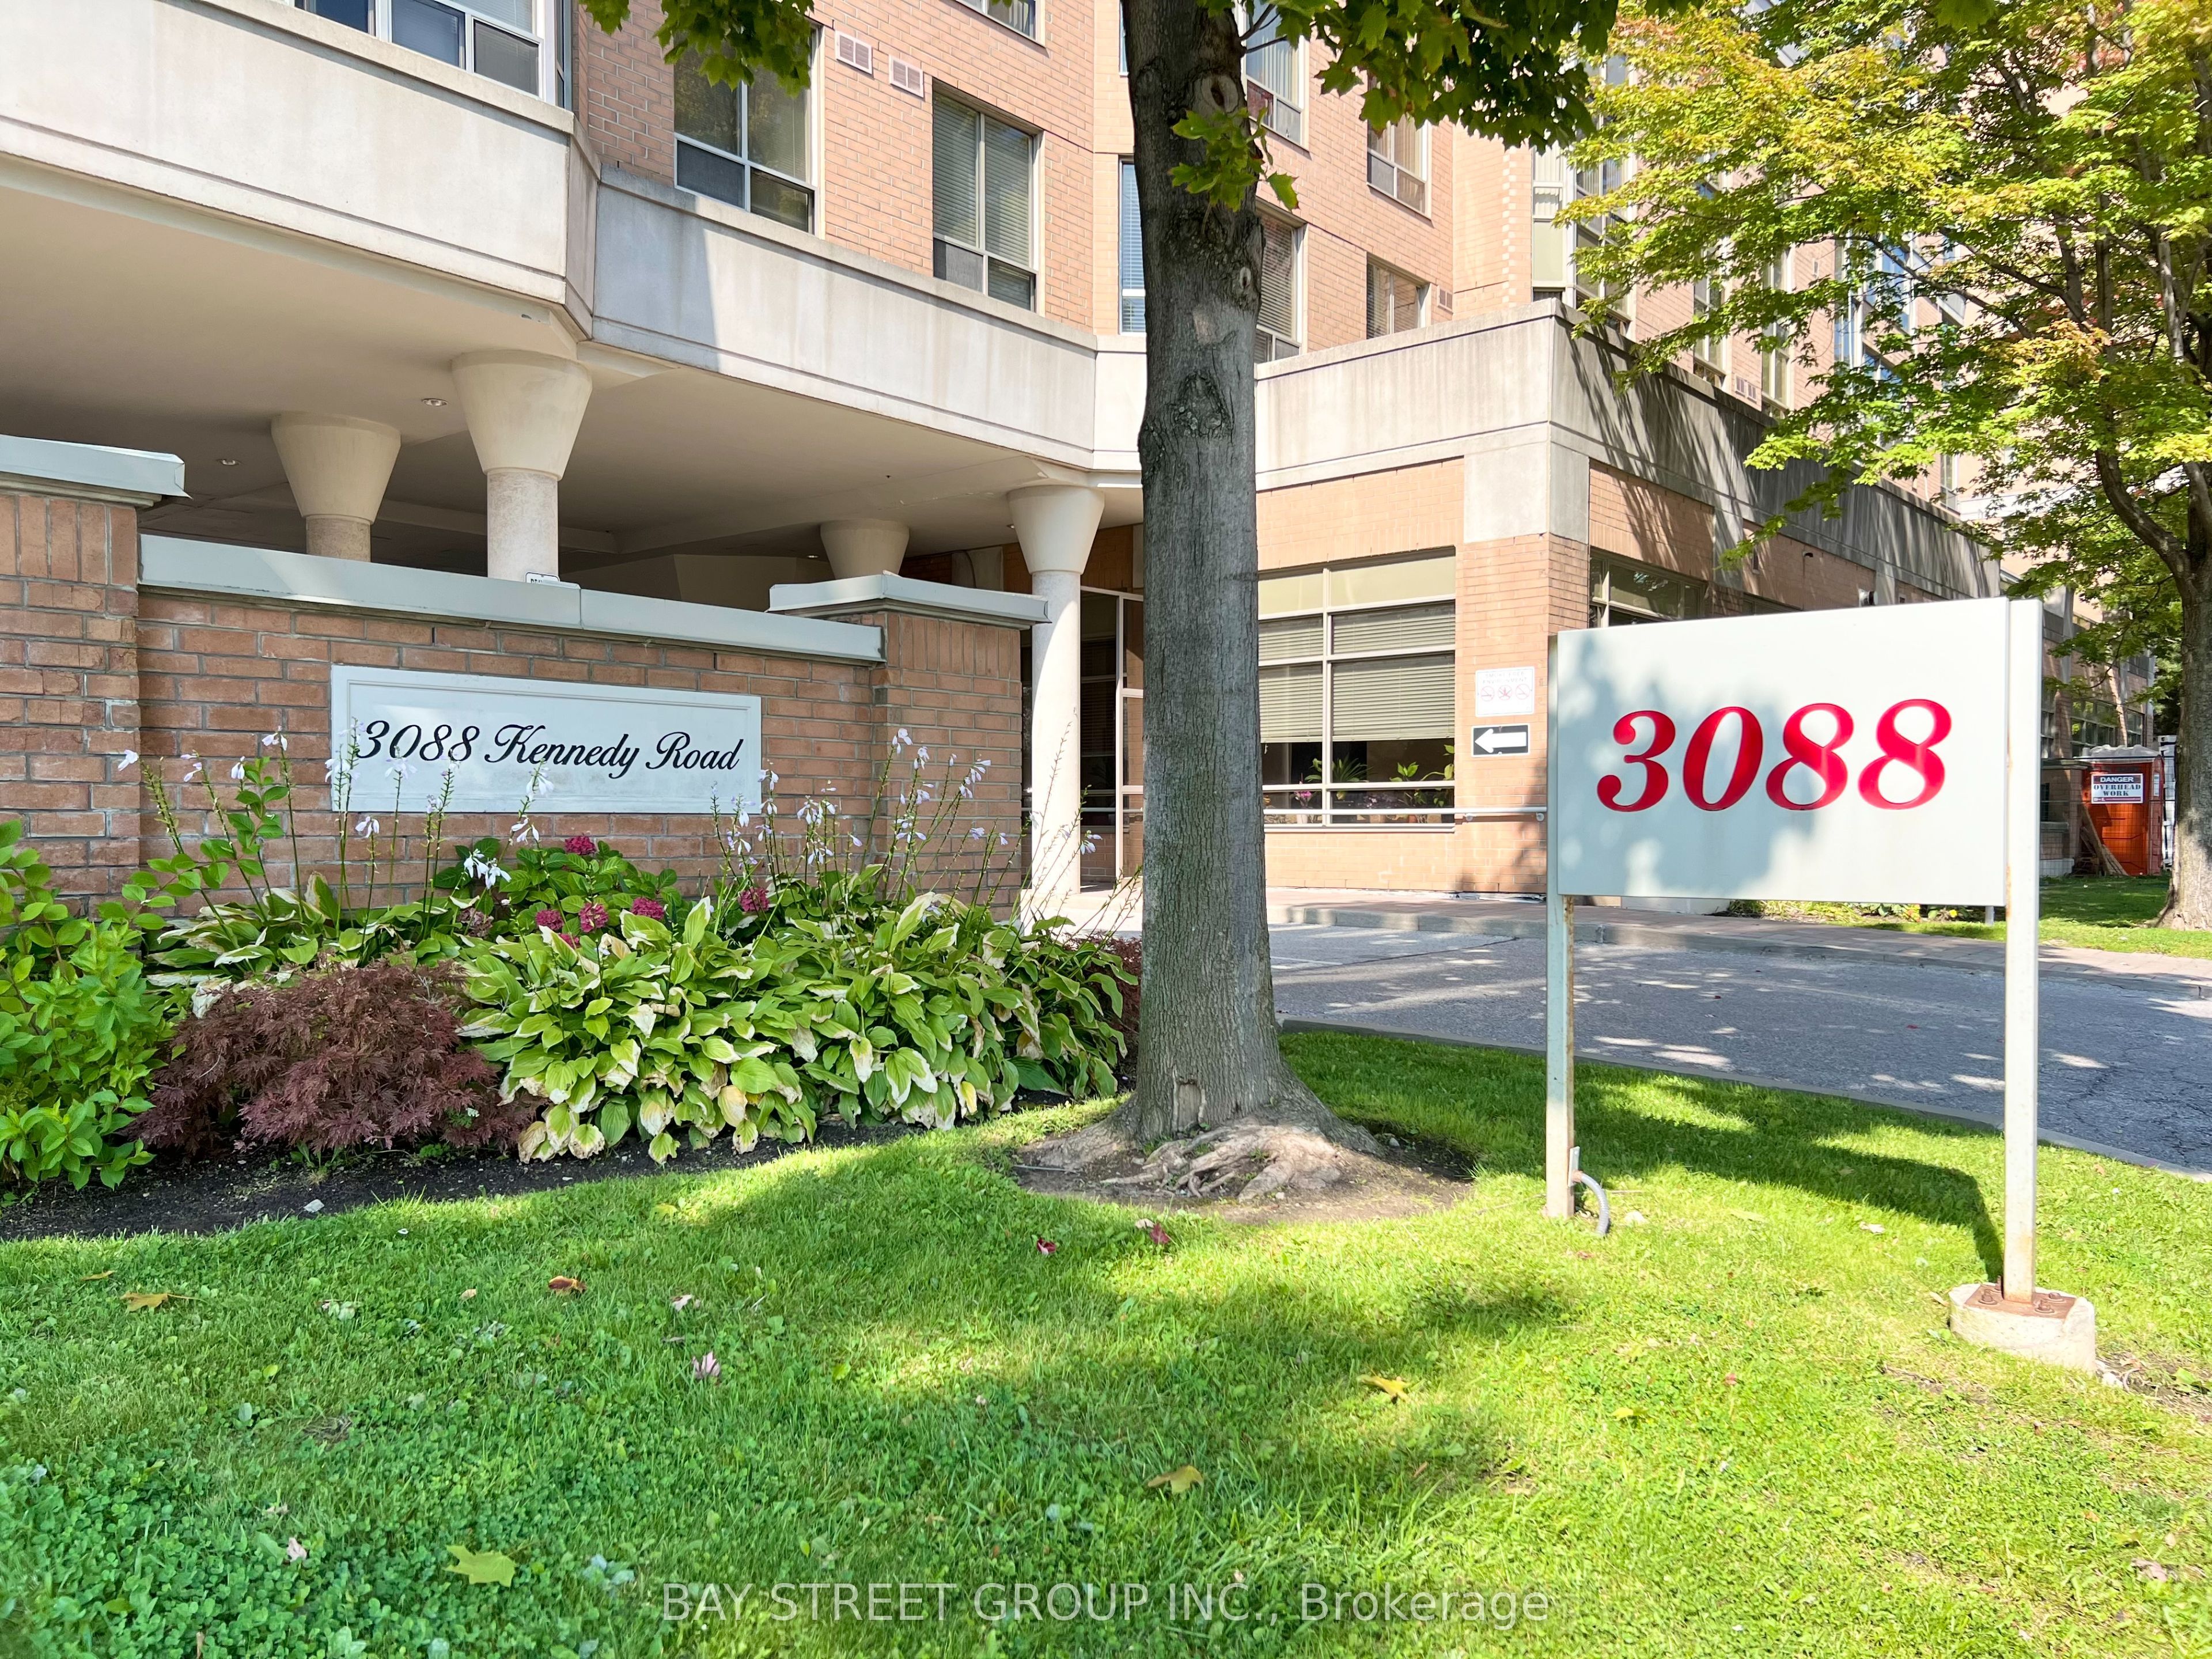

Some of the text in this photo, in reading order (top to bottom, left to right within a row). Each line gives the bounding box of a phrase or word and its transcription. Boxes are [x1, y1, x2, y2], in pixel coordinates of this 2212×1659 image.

[357, 720, 744, 779] 3088 Kennedy Road
[1596, 698, 1952, 812] 3088
